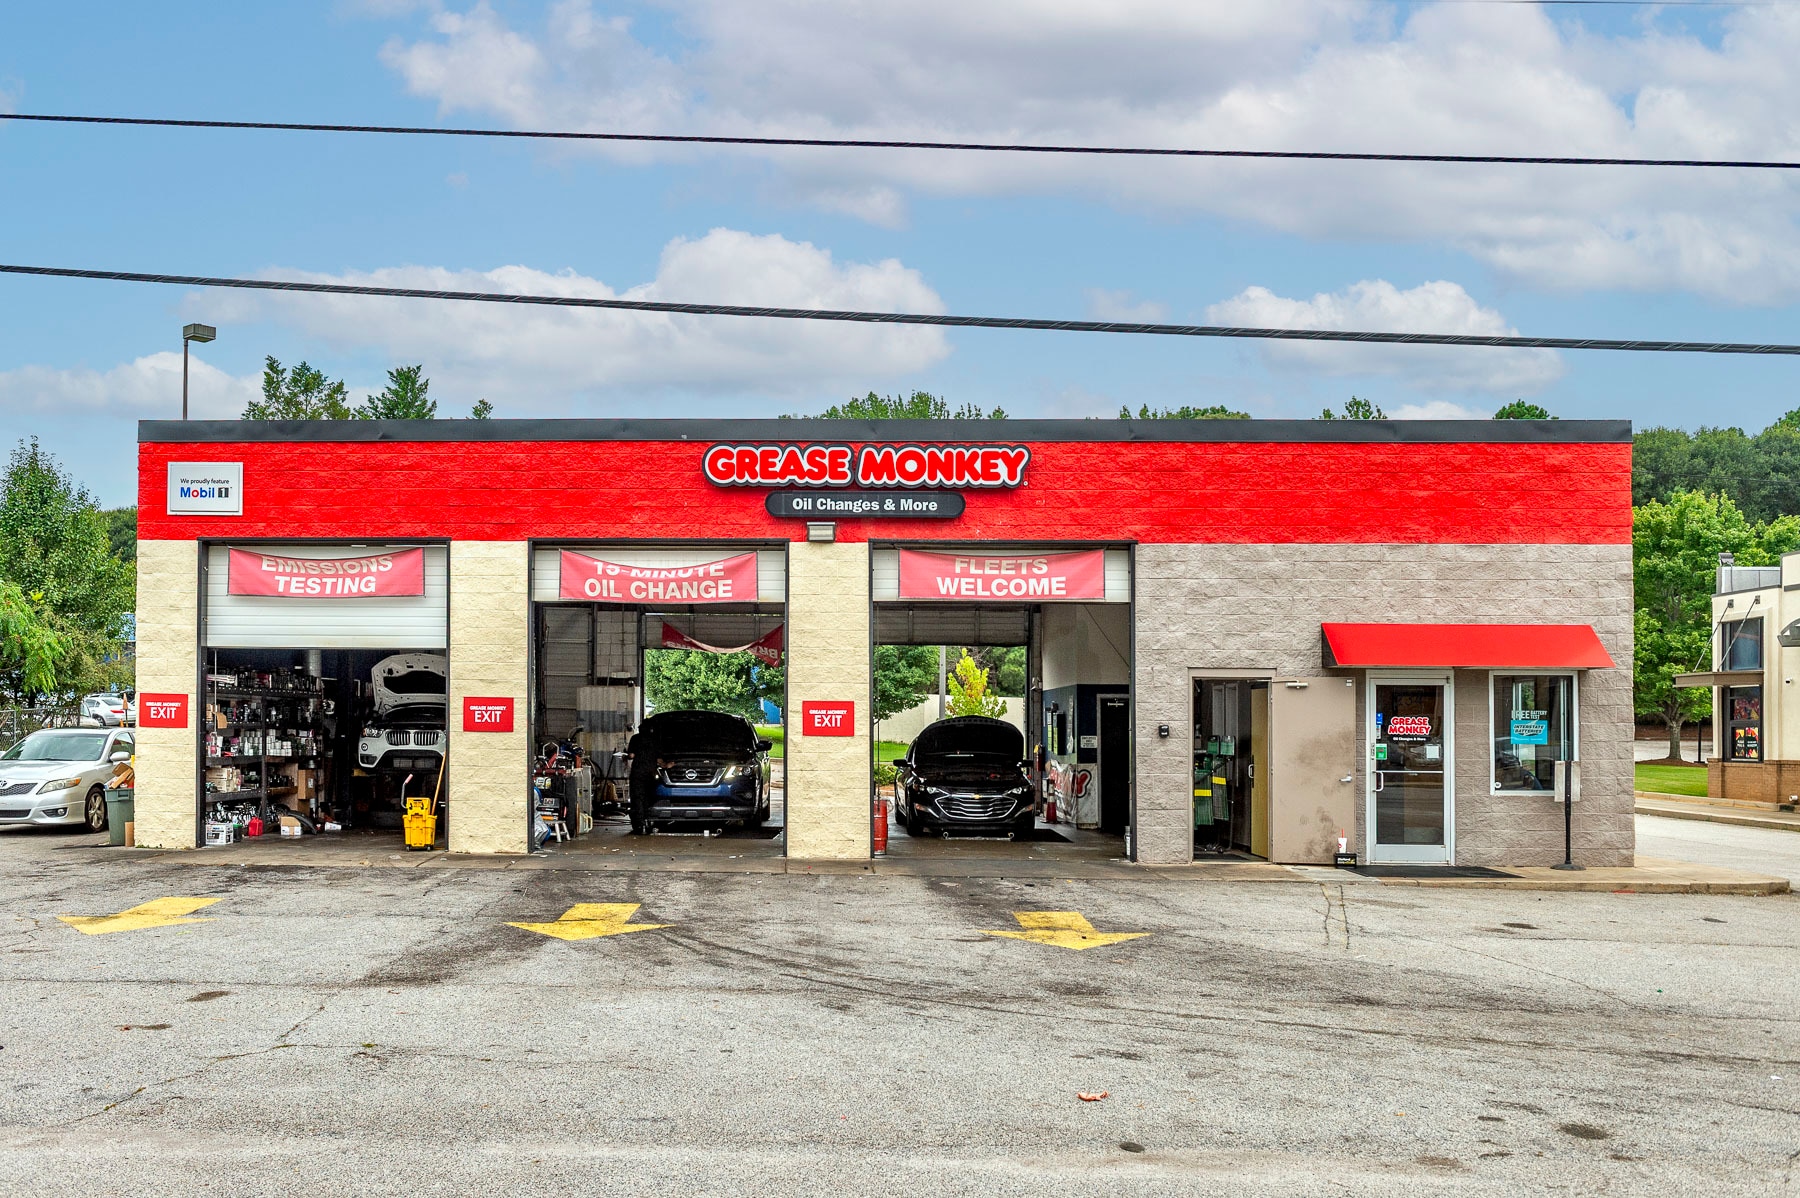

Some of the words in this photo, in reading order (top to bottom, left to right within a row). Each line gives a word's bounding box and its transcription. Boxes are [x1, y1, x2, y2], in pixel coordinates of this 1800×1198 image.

[704, 446, 853, 484] GREASE
[856, 447, 1027, 485] MONKEY
[180, 487, 215, 498] Mobil
[218, 487, 229, 498] 1
[792, 498, 812, 511] Oil
[816, 498, 880, 512] Changes
[884, 499, 897, 511] &
[900, 499, 938, 511] More
[261, 555, 393, 575] EMISSIONS
[593, 561, 725, 579] 15-MINUTE
[955, 557, 1048, 575] FLEETS
[274, 575, 377, 594] TESTING
[584, 578, 622, 598] OIL
[630, 579, 733, 600] CHANGE
[936, 576, 1067, 596] WELCOME
[150, 707, 177, 719] EXIT
[474, 711, 502, 723] EXIT
[814, 714, 842, 727] EXIT
[1390, 717, 1429, 726] GREASE
[1388, 725, 1431, 735] MONKEY
